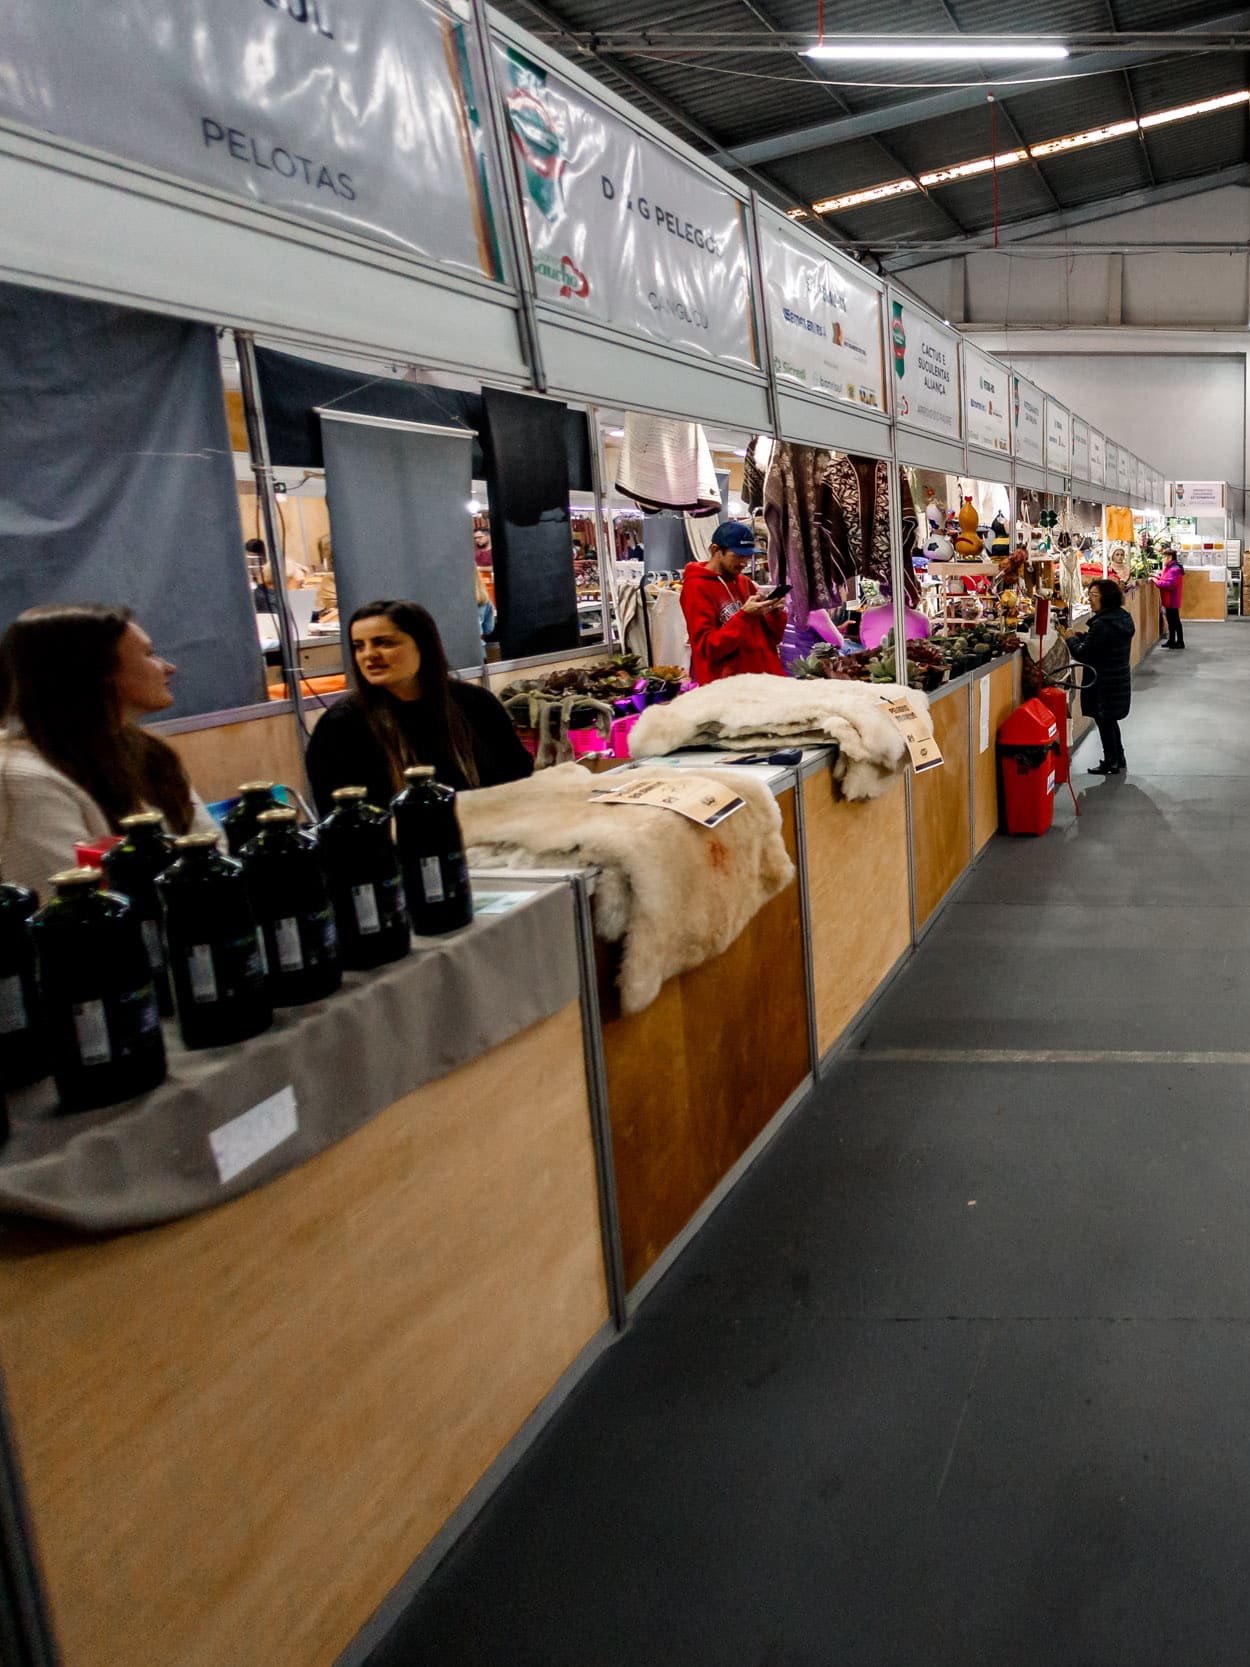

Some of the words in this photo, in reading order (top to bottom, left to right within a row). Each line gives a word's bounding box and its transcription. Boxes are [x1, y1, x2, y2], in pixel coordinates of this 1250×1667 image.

[201, 117, 357, 201] PELOTAS
[921, 342, 942, 364] CACTUS
[917, 357, 950, 383] SUCULENTAS
[924, 375, 946, 395] ALIANÇA
